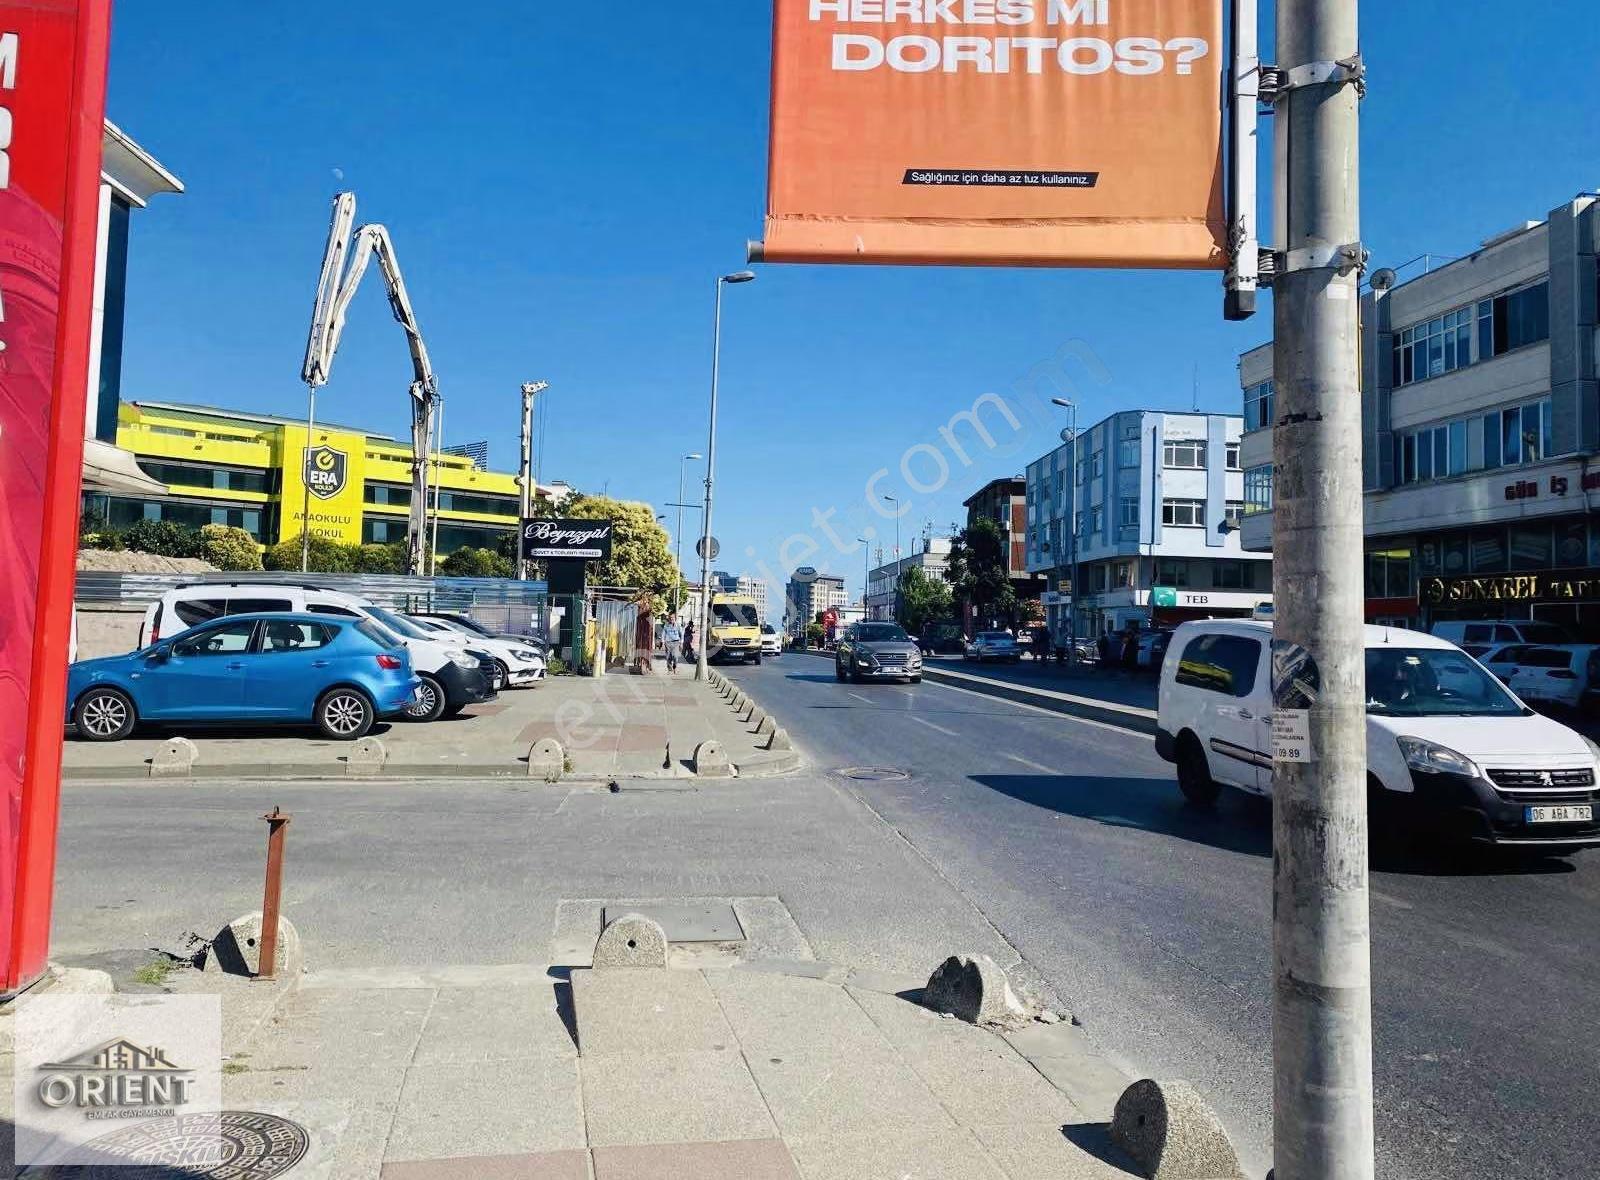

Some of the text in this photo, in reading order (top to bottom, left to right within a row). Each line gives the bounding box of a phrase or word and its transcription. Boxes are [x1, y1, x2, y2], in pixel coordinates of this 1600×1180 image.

[808, 0, 1034, 25] HERKES
[831, 35, 1209, 76] DORITOS?
[911, 171, 960, 185] Sağlığınız
[962, 173, 979, 185] için
[982, 174, 1006, 184] daha
[1009, 175, 1022, 184] az
[1024, 175, 1039, 184] tuz
[309, 470, 338, 486] ERA
[1185, 595, 1208, 604] TEB
[1533, 808, 1545, 821] 06
